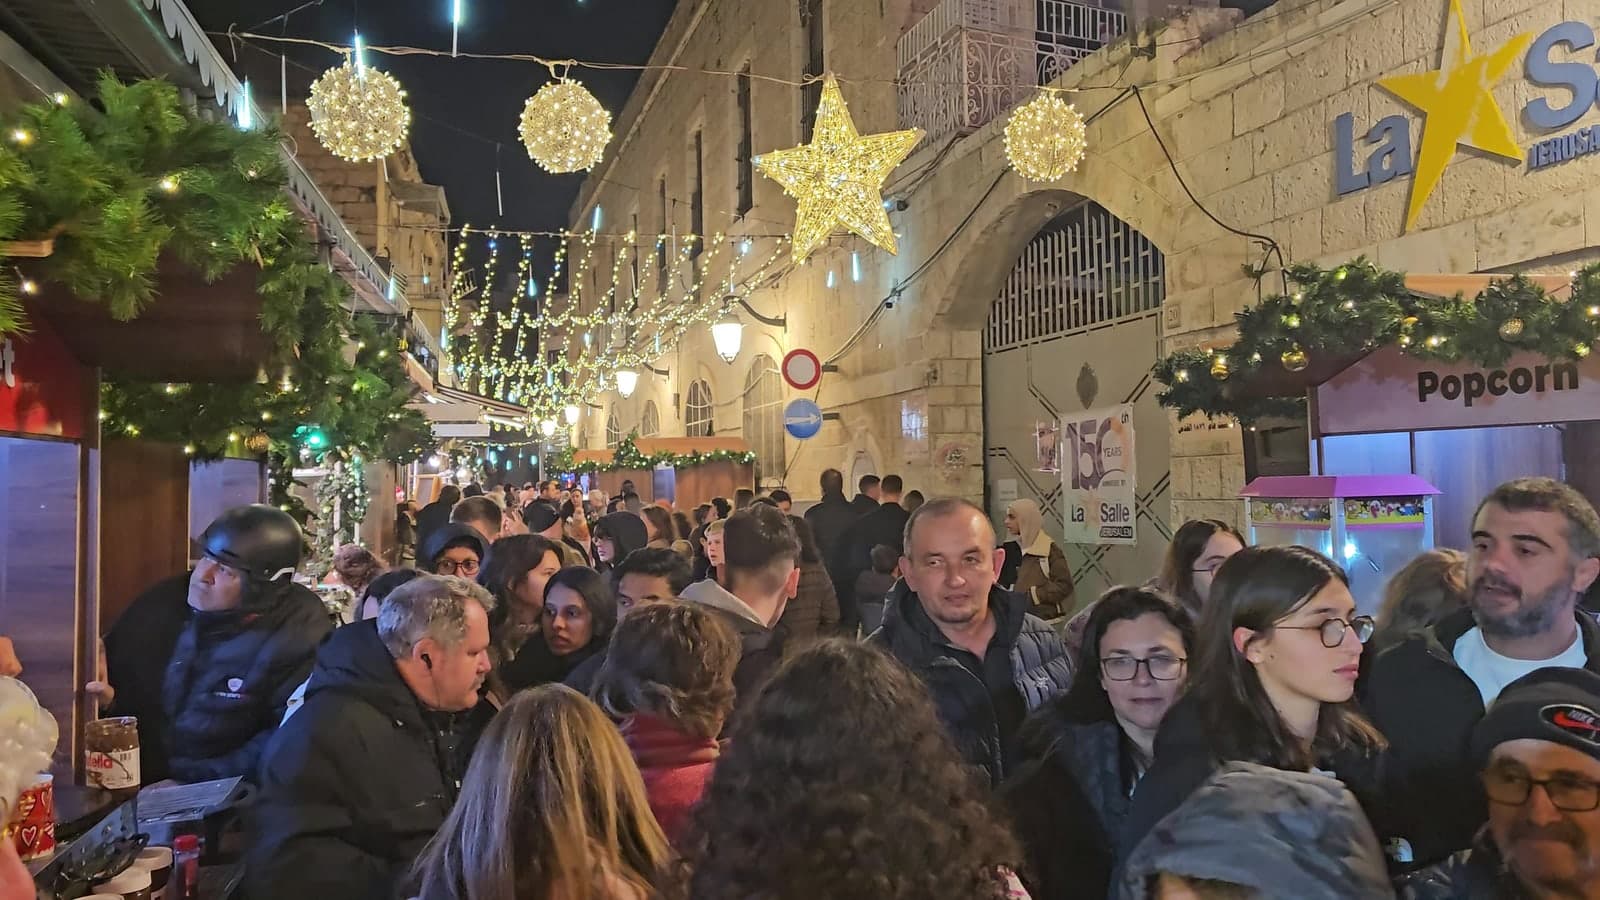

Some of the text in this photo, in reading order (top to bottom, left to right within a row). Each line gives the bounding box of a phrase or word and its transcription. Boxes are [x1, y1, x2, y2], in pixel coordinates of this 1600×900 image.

[1335, 21, 1600, 195] La S
[1417, 362, 1579, 407] Popcorn
[1103, 447, 1122, 457] YEARS
[1072, 503, 1129, 522] La Salle
